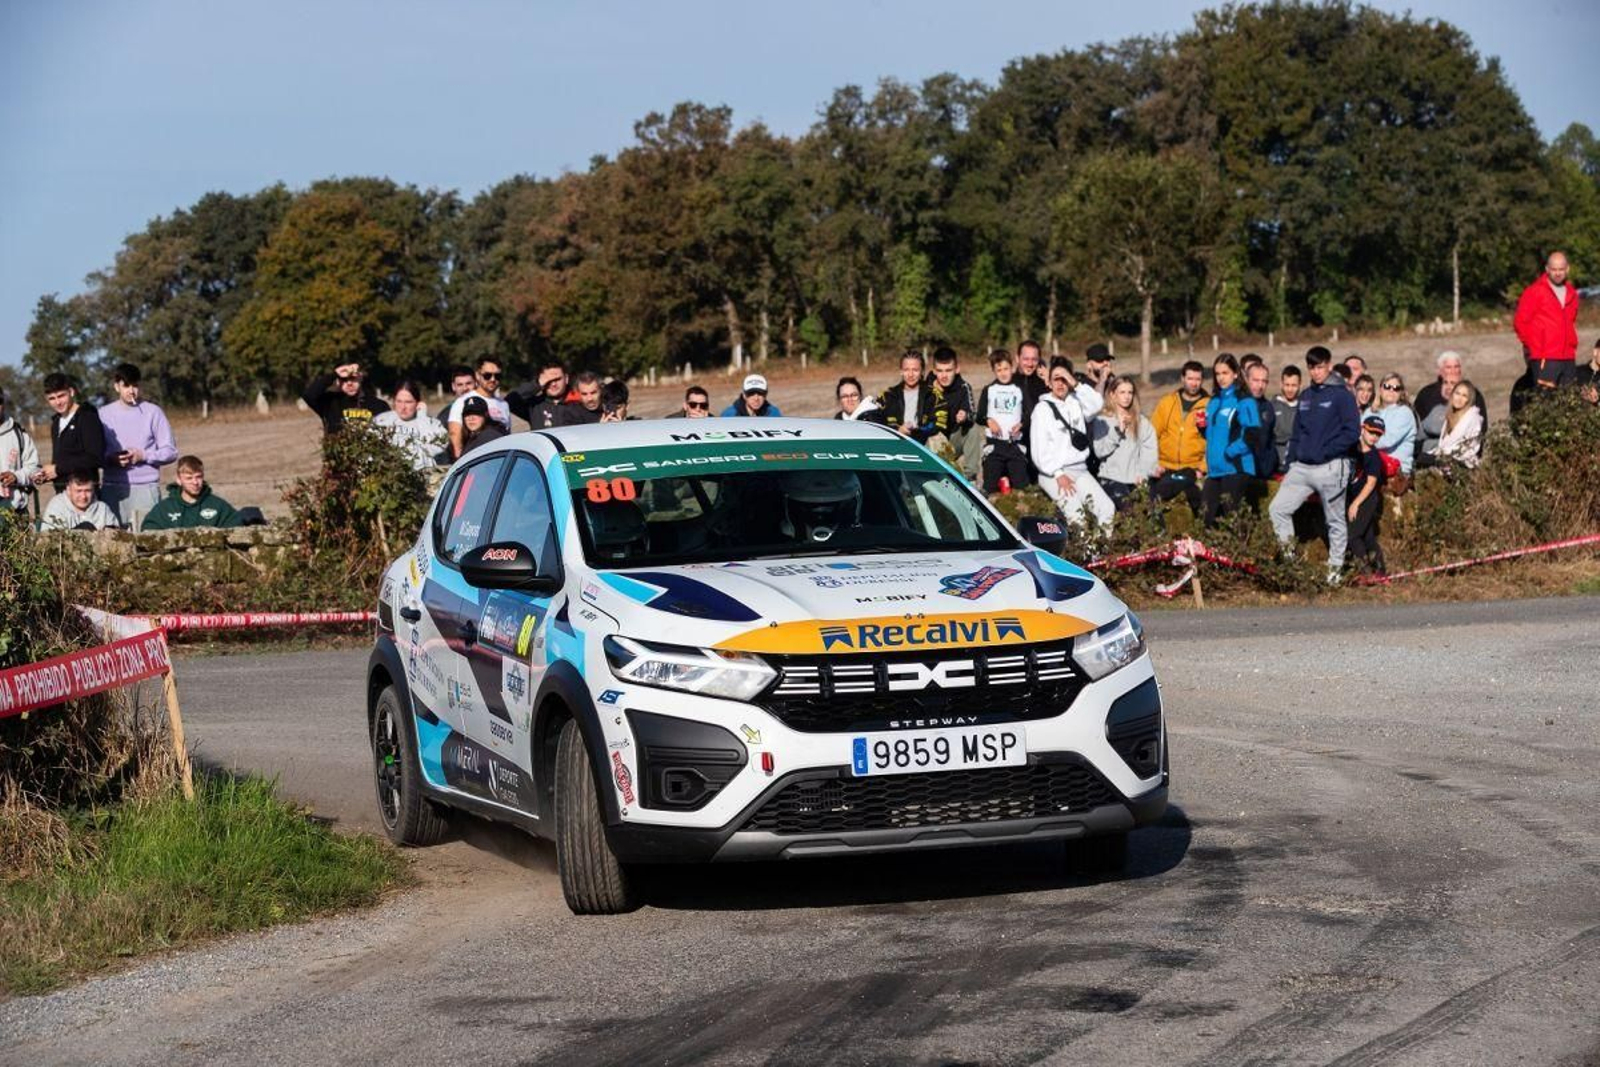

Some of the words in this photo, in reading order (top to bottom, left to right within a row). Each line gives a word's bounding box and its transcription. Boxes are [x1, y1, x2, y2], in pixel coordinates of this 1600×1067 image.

[670, 429, 803, 441] MOBIFY
[642, 453, 757, 469] SANDERO
[761, 452, 808, 461] ECO
[813, 452, 859, 460] CUP
[586, 477, 636, 503] 80
[482, 548, 517, 561] AON
[858, 618, 990, 648] Recalvi
[14, 663, 72, 706] PROHIBIDO
[71, 651, 117, 692] PUBLICO
[116, 643, 147, 680] ZONA
[890, 716, 978, 728] STEPWAY
[873, 736, 950, 769] 9859
[962, 732, 1017, 763] MSP
[857, 760, 864, 769] E
